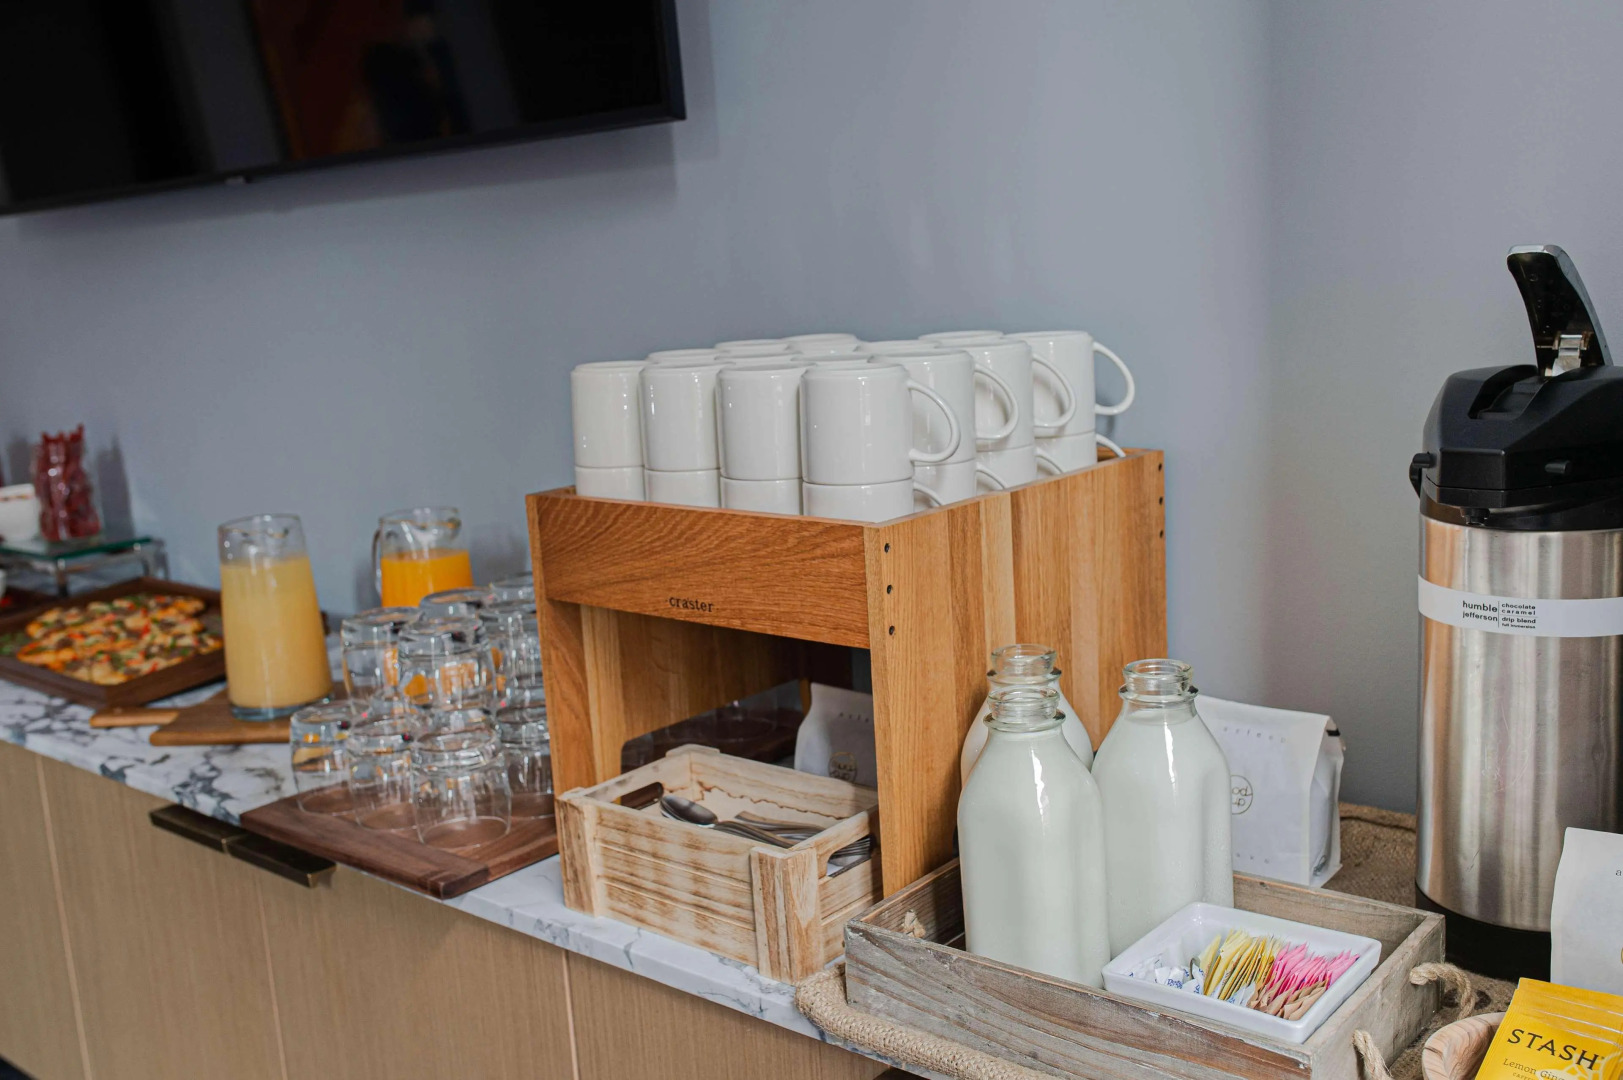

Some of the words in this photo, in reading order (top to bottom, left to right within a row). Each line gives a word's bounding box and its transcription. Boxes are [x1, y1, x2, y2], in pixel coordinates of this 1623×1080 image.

[669, 597, 714, 612] craster
[1462, 600, 1498, 613] humble
[1462, 611, 1498, 622] jefferson
[1507, 1028, 1599, 1070] STASH
[1503, 1058, 1537, 1075] Lemon
